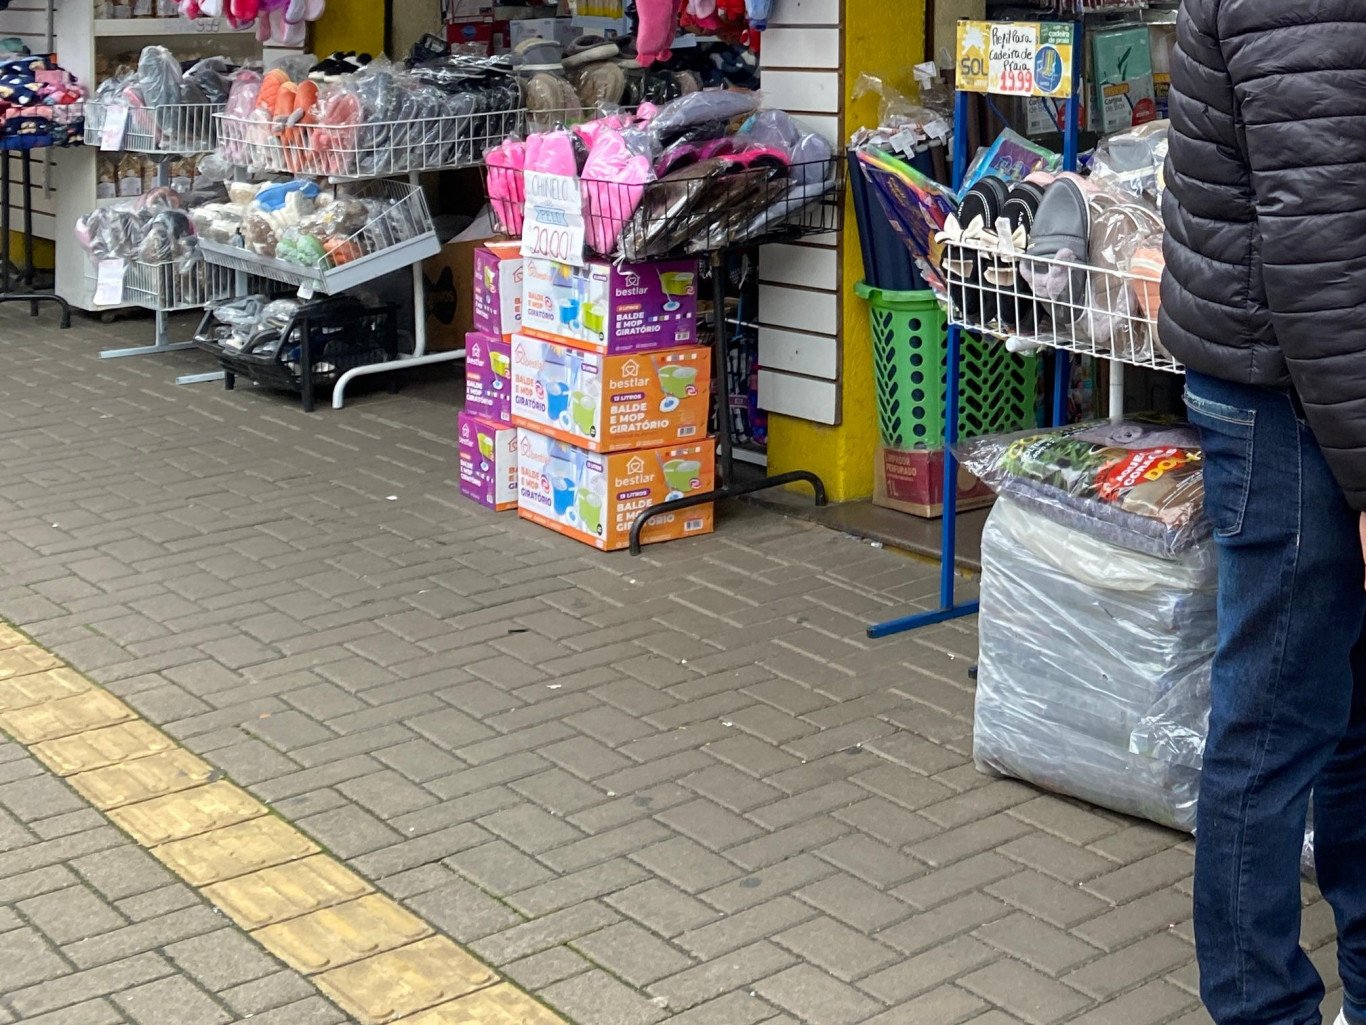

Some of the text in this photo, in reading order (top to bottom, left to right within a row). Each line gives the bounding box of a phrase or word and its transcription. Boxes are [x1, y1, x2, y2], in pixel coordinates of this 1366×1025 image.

[961, 58, 988, 76] SOL
[1004, 60, 1030, 71] Praia
[616, 312, 644, 321] BALDE
[623, 320, 643, 328] MOP
[615, 324, 661, 336] GIRATÓRIO
[610, 403, 647, 414] BALDE
[610, 413, 645, 424] E MOP
[609, 420, 669, 434] GIRATÓRIO
[617, 499, 653, 512] BALDE
[616, 514, 623, 522] E
